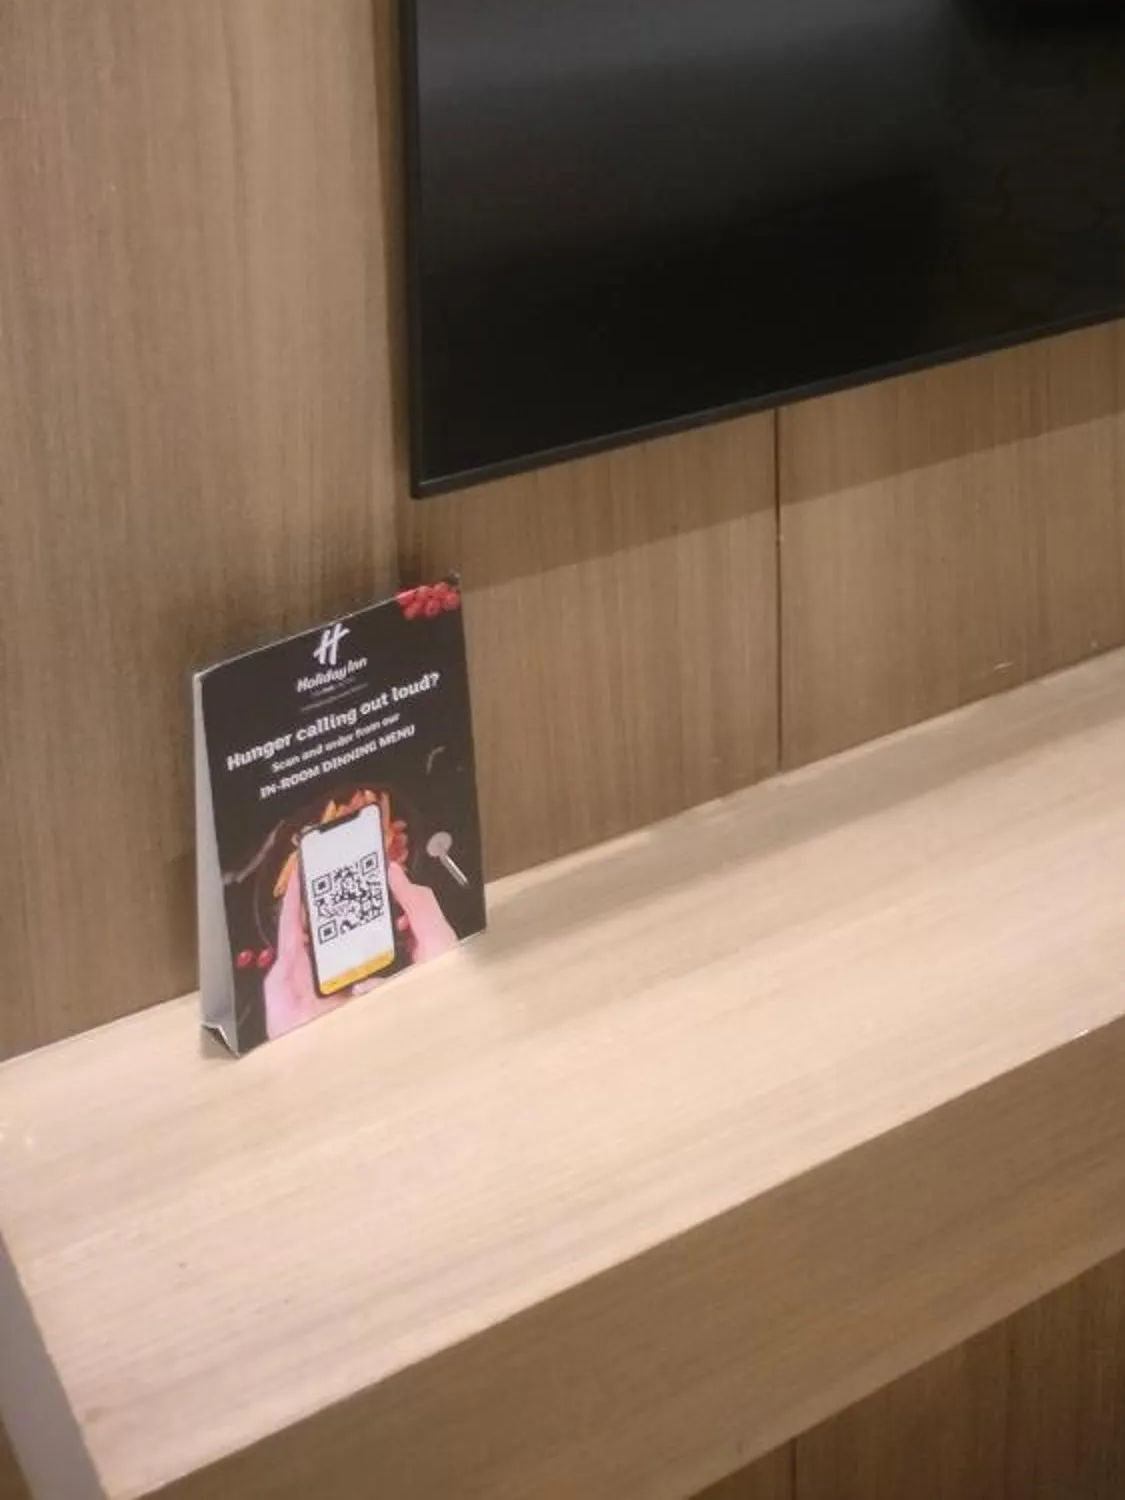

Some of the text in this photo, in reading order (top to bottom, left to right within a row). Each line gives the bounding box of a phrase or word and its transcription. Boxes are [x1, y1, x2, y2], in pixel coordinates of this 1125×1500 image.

[297, 665, 346, 692] Holiday
[347, 657, 368, 673] Inn
[227, 733, 293, 771] Hunger
[295, 708, 357, 741] calling
[360, 692, 389, 715] out
[391, 672, 440, 701] loud?
[301, 744, 323, 761] and
[355, 721, 381, 738] from
[259, 765, 321, 799] IN-ROOM
[379, 724, 416, 748] MENU
